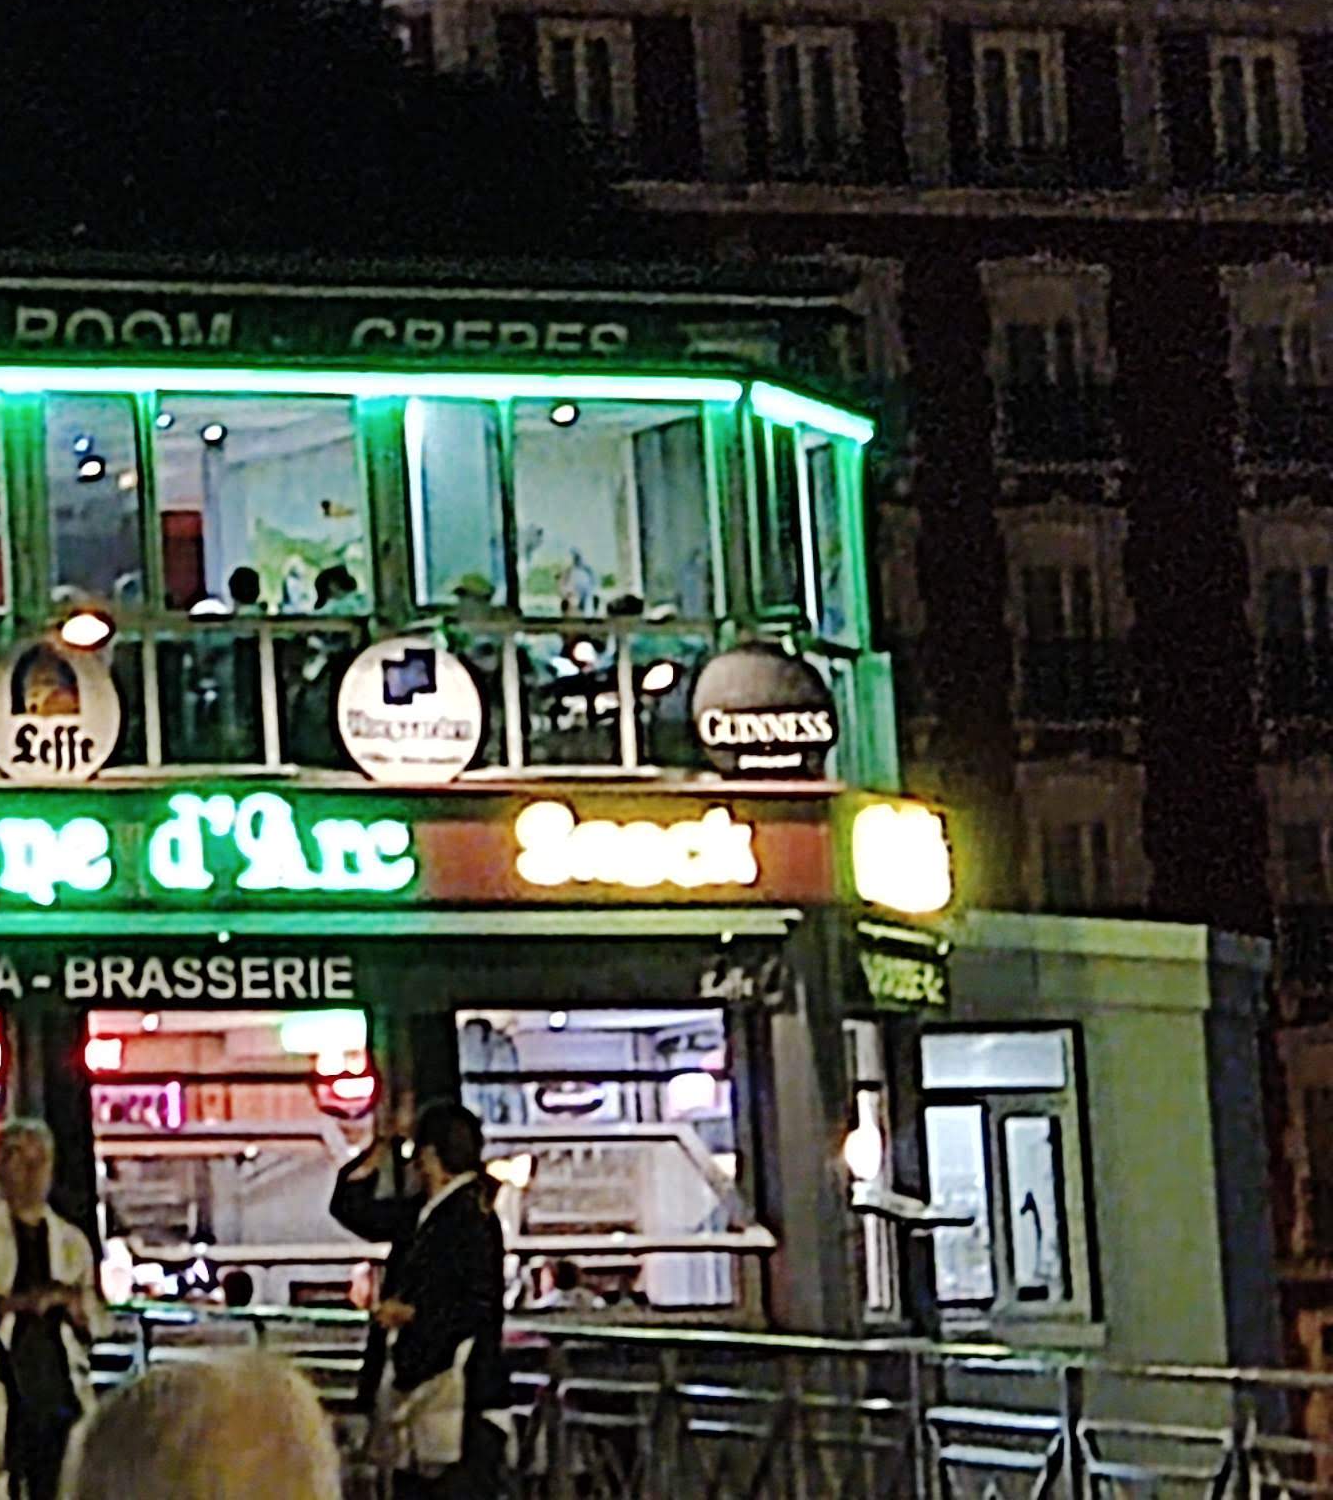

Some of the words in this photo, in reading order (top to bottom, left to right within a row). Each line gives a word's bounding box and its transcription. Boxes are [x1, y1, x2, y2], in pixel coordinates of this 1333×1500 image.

[13, 304, 233, 346] ROOM
[699, 708, 833, 745] GUINNESS
[147, 792, 417, 894] d'Arc
[64, 956, 354, 1000] BRASSERIE
